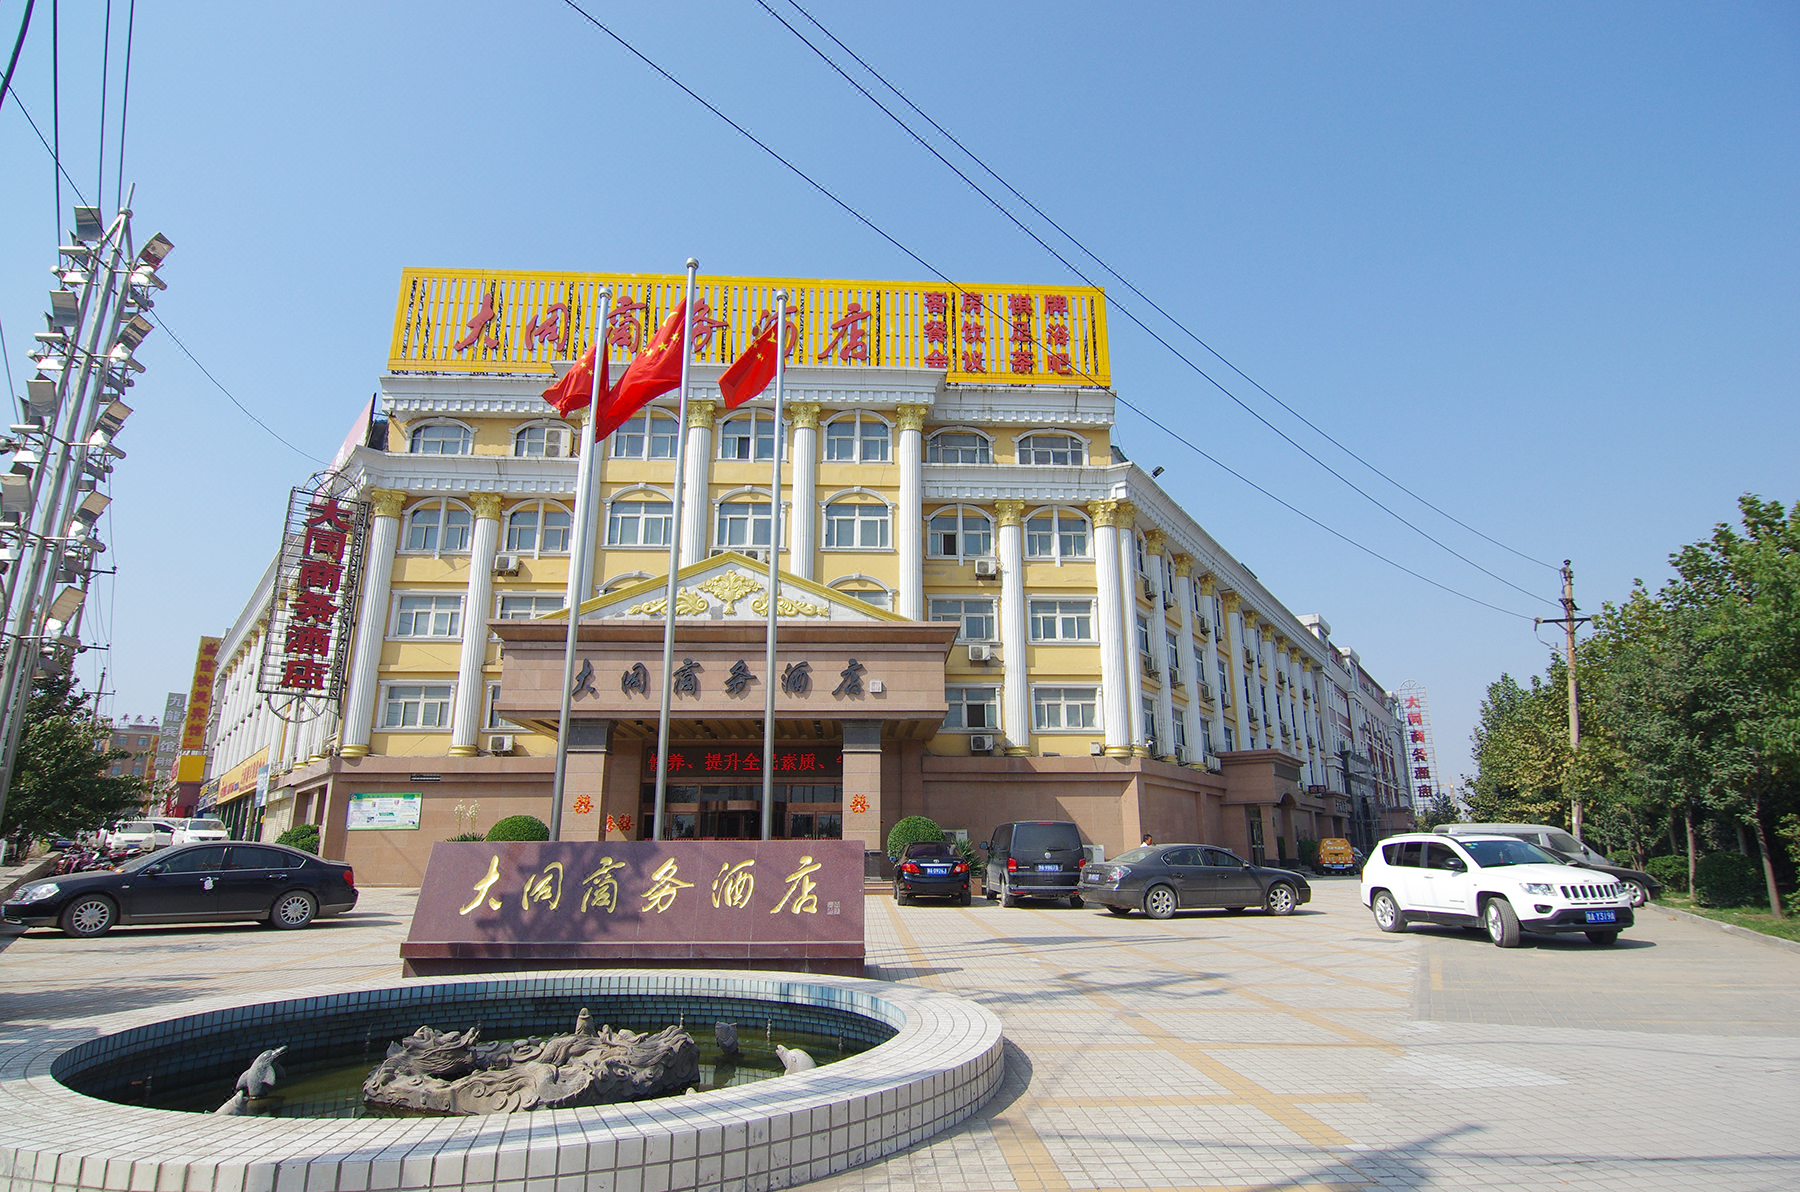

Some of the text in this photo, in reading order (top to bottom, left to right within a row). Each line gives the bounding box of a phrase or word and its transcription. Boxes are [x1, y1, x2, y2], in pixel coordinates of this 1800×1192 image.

[924, 291, 1068, 316] 客房 棋牌
[924, 319, 1069, 346] 餐饮 足浴
[925, 349, 1072, 374] 会议 茶吧
[280, 500, 353, 690] 大同商务酒店
[572, 658, 863, 696] 大同商务酒店
[648, 752, 842, 771] 养、提升全素质、
[1405, 696, 1434, 797] 大同商务酒店
[459, 855, 822, 915] 大同商务酒店
